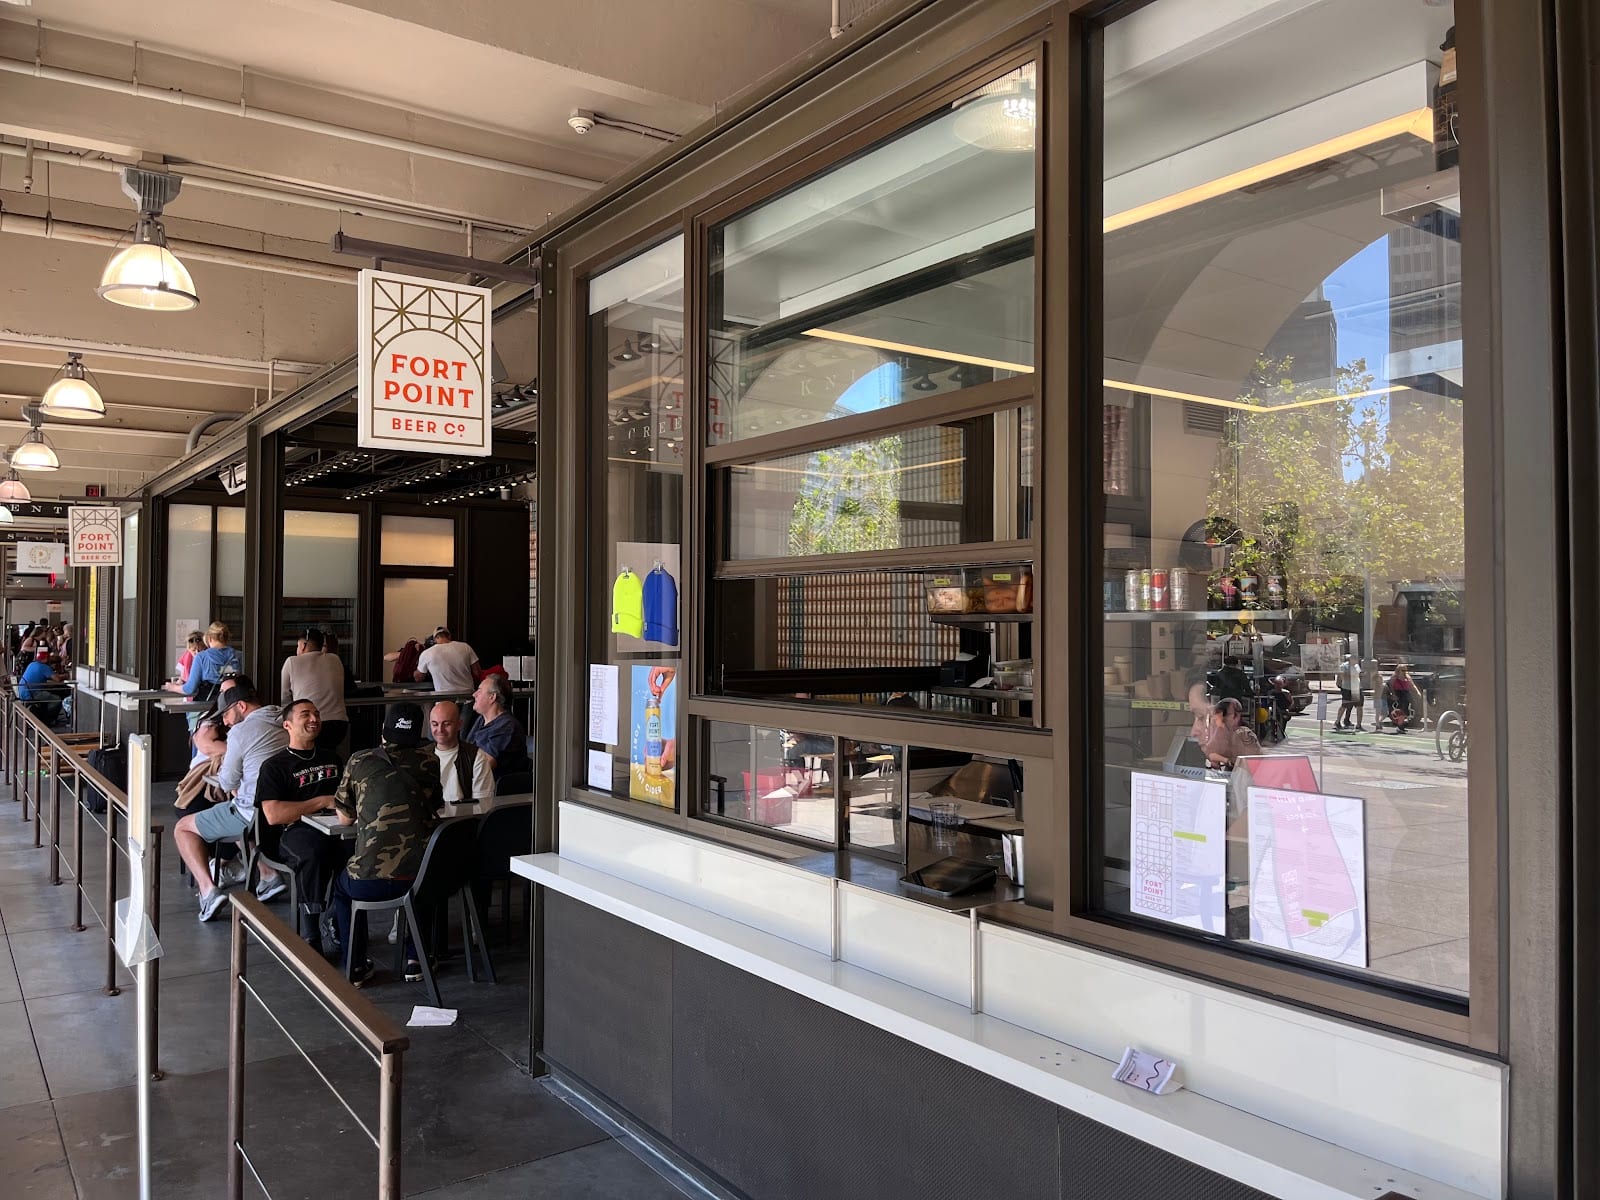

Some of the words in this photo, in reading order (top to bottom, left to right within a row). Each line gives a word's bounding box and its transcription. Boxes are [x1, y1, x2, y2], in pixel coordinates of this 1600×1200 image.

[391, 353, 468, 381] FORT
[383, 380, 474, 409] POINT
[392, 417, 437, 434] BEER
[80, 533, 112, 541] FORT
[78, 542, 115, 551] POINT
[645, 783, 662, 795] CIDER
[1145, 879, 1163, 889] FORT
[1144, 886, 1164, 896] POINT
